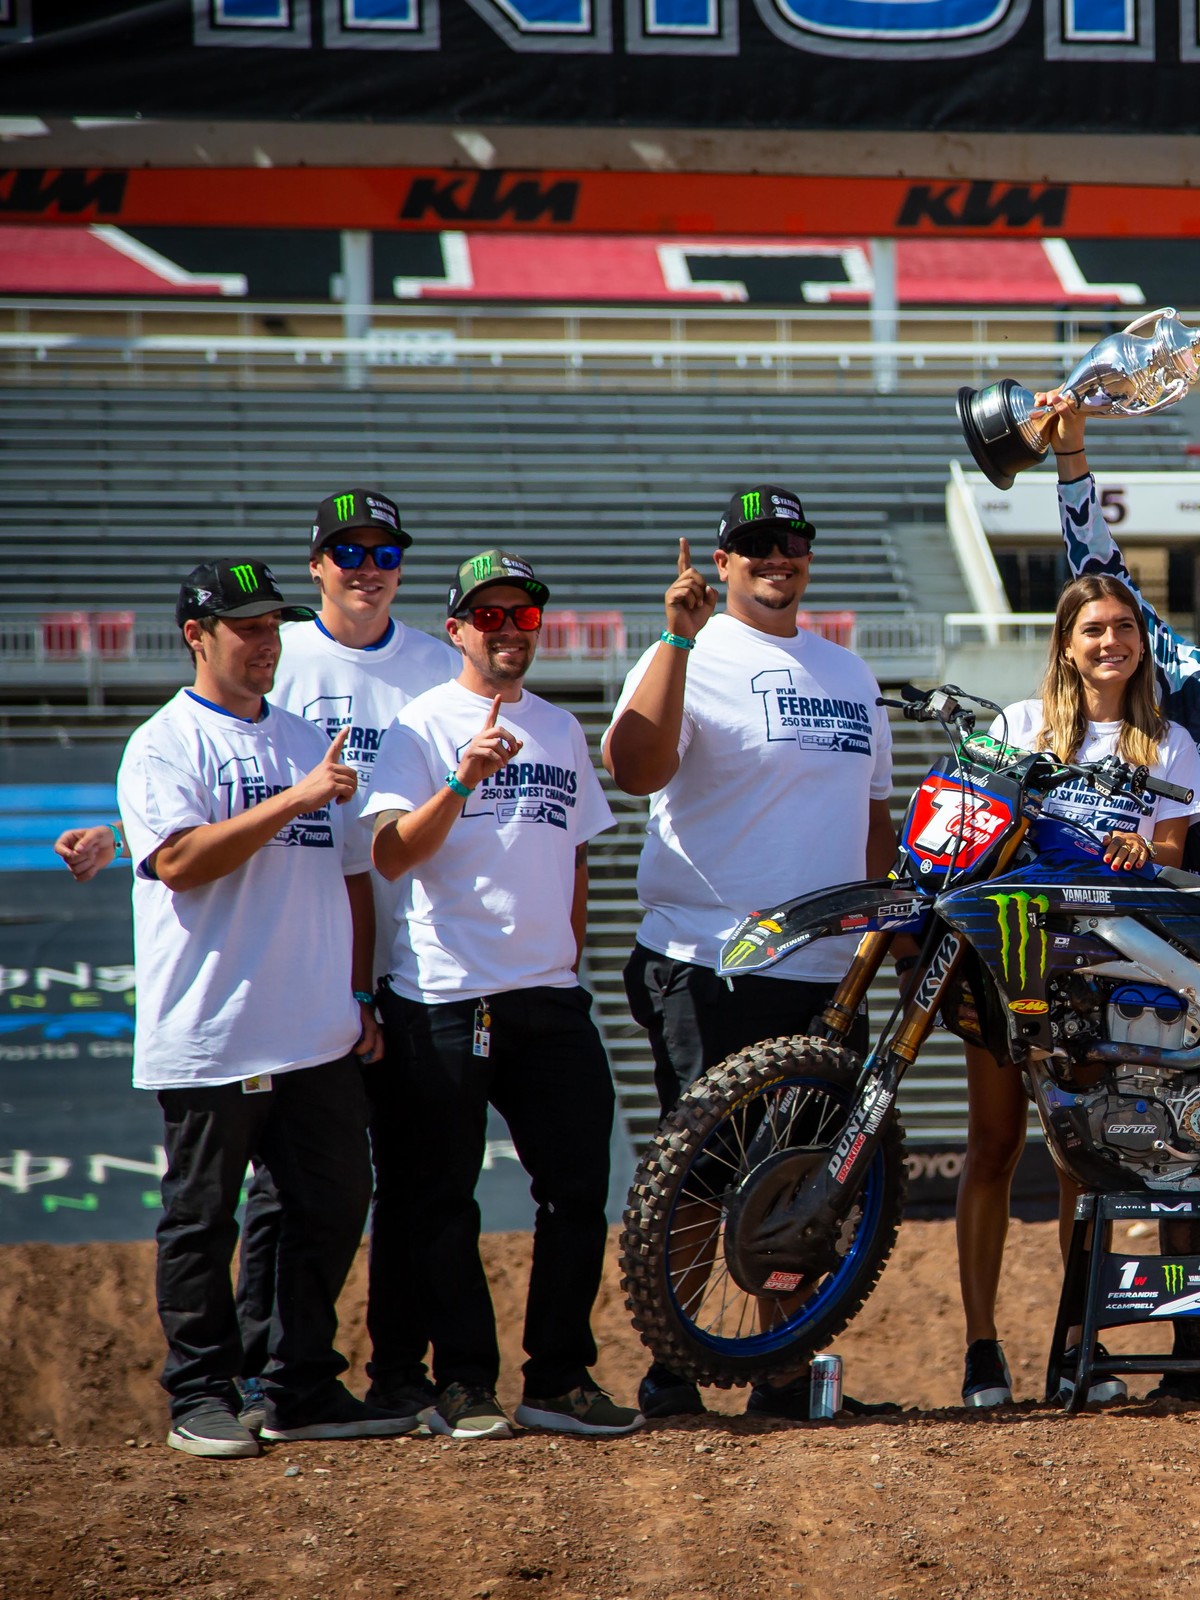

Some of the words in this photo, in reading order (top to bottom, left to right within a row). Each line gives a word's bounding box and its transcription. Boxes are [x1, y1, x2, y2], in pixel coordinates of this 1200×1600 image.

[0, 169, 129, 215] TM
[400, 170, 581, 222] KTM
[896, 181, 1069, 228] KTM
[1100, 489, 1127, 524] 5
[775, 687, 797, 696] DYLAN
[777, 696, 870, 724] FERRANDIS
[326, 716, 353, 726] DYLAN
[781, 717, 800, 727] 250
[801, 718, 812, 728] SX
[813, 718, 835, 729] WEST
[837, 718, 873, 736] CHAMPION
[847, 738, 869, 750] THOR
[361, 752, 378, 763] WE
[241, 776, 265, 786] DYLAN
[480, 788, 502, 800] 250
[503, 788, 516, 799] SX
[518, 786, 544, 799] WEST
[1059, 788, 1074, 802] SX
[1074, 791, 1102, 807] WEST
[1102, 798, 1156, 818] CHAMPIN
[914, 788, 993, 858] 1
[970, 810, 1006, 834] SX
[1105, 817, 1137, 832] THOR
[304, 831, 331, 842] THOR
[1061, 888, 1112, 904] YAMALUBE
[914, 933, 961, 1013] KYB
[862, 1089, 895, 1136] YAMALUBE
[1107, 1124, 1158, 1135] GYTR
[835, 1131, 867, 1185] BRAKING
[903, 1152, 967, 1180] OYO
[770, 1272, 804, 1283] LIGHT
[1118, 1261, 1141, 1290] 1
[1134, 1275, 1149, 1287] W
[764, 1281, 797, 1291] SPEED
[1108, 1291, 1160, 1300] FERRANDIS
